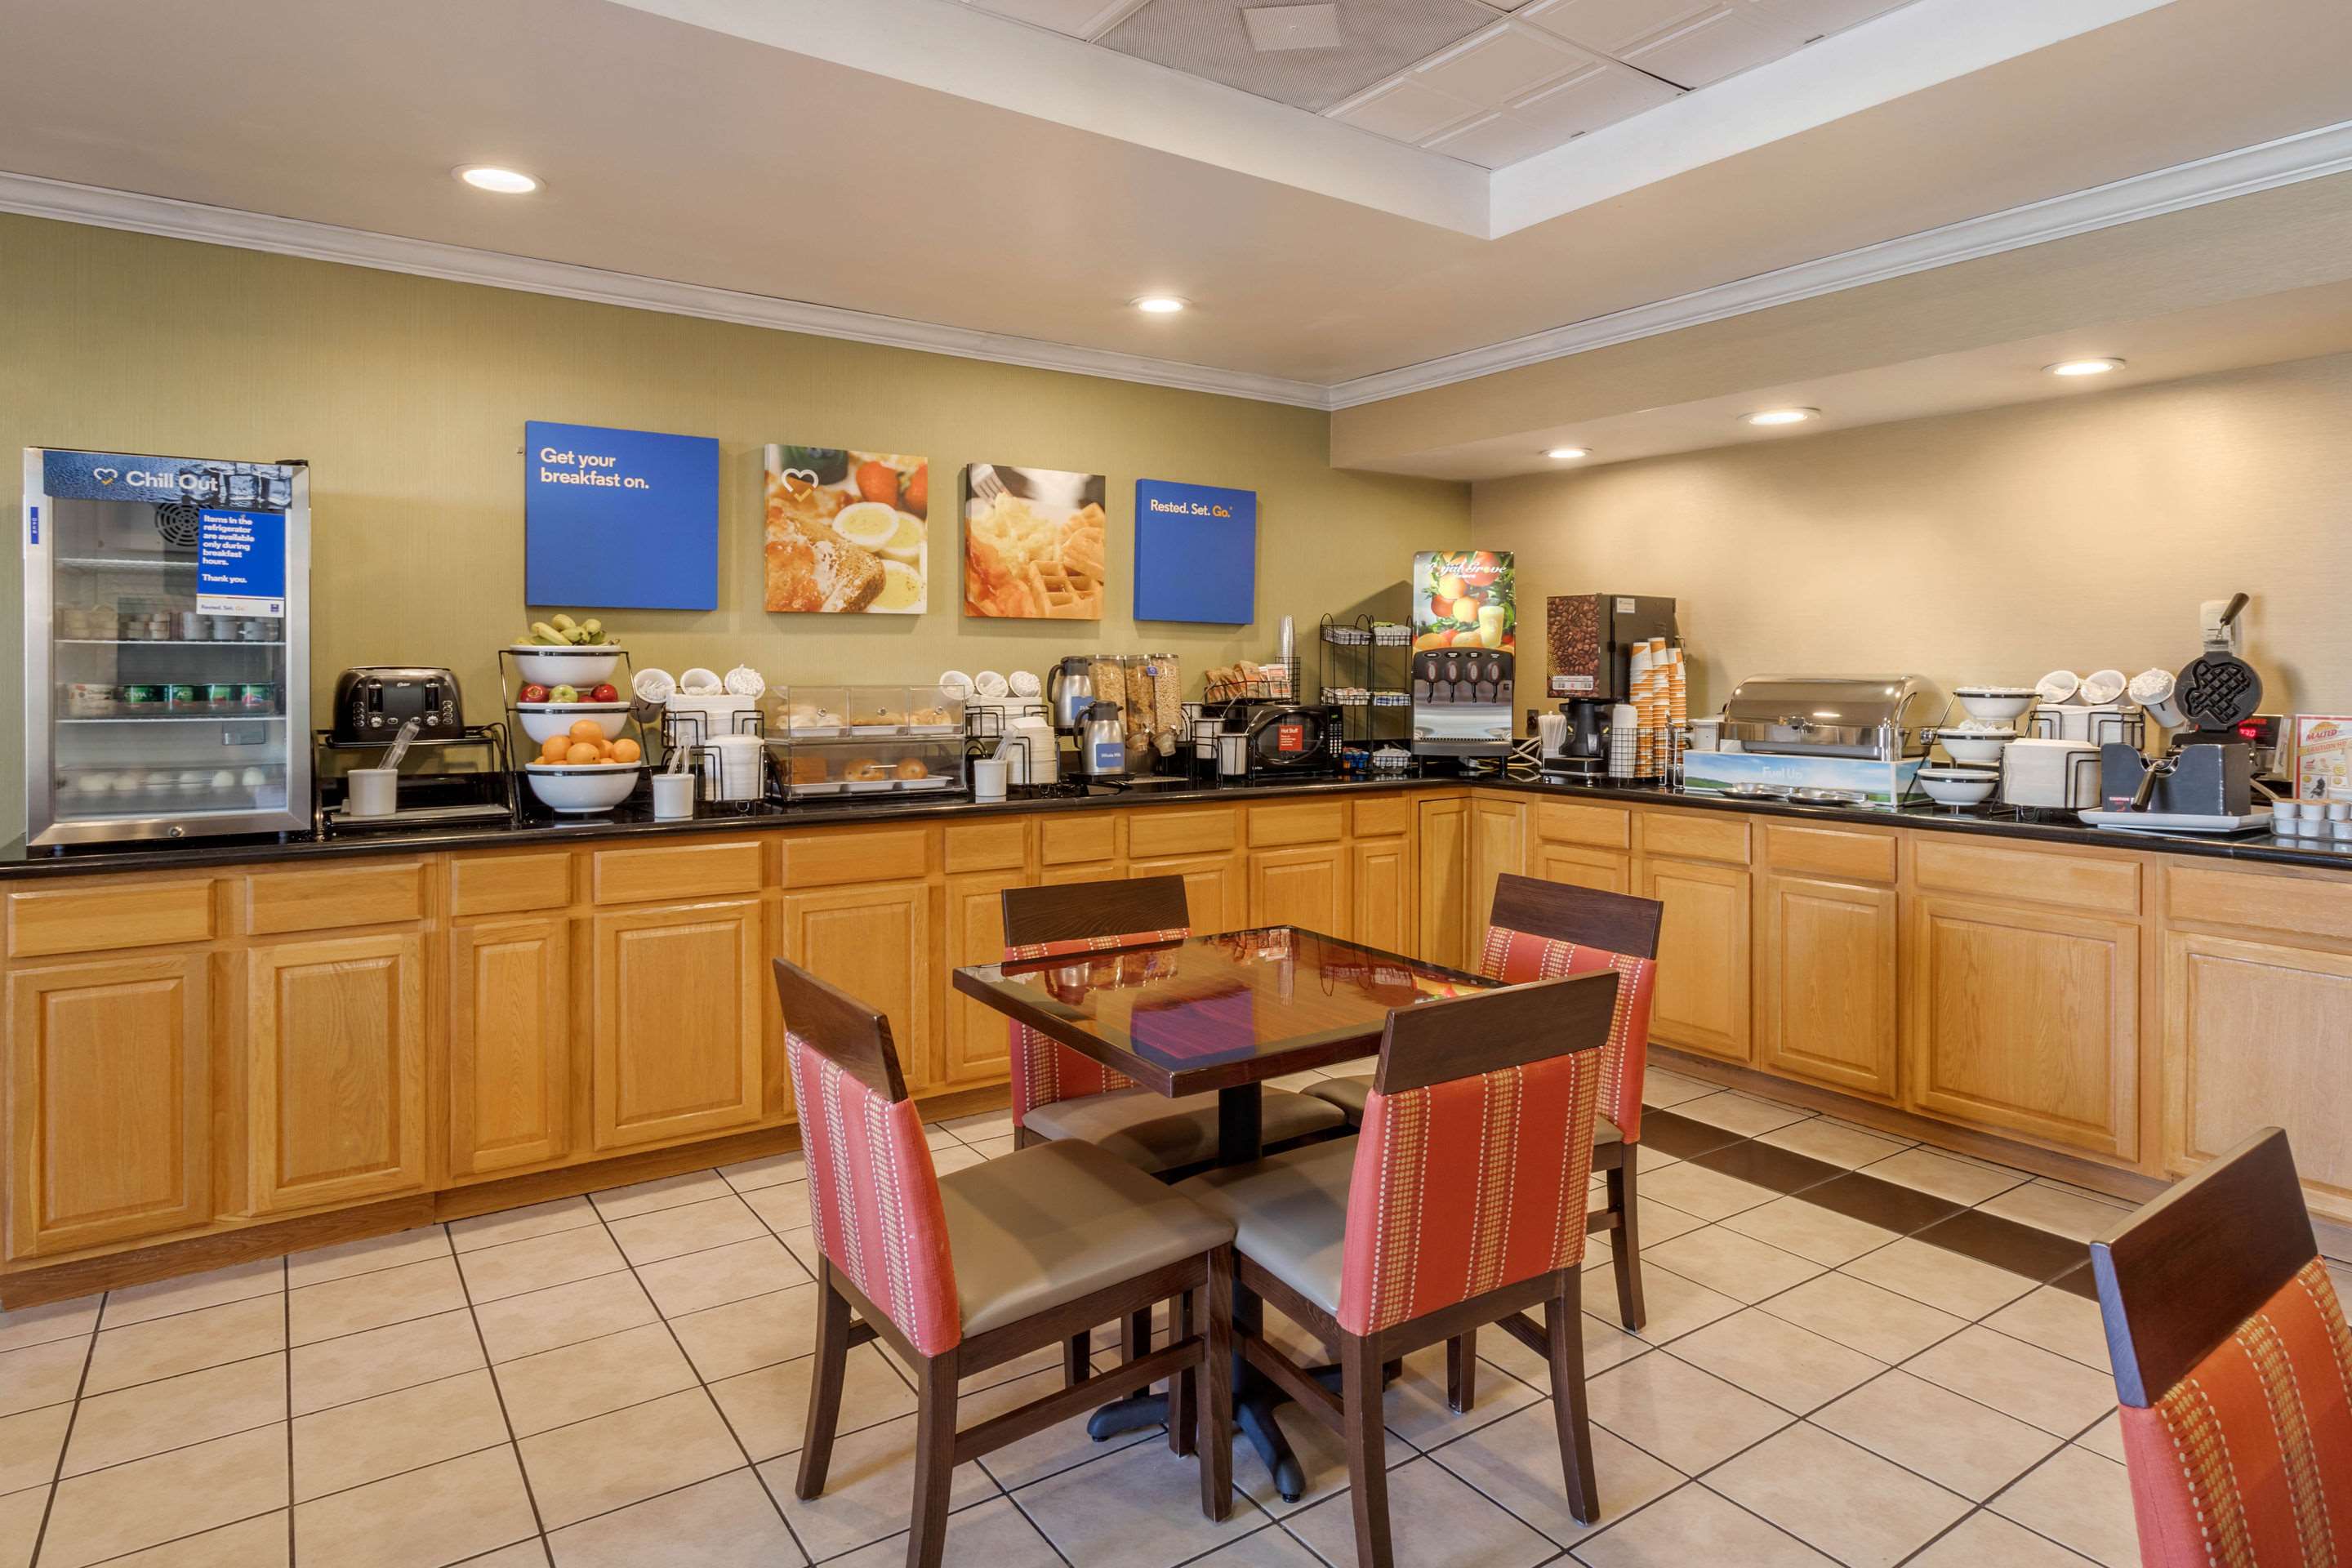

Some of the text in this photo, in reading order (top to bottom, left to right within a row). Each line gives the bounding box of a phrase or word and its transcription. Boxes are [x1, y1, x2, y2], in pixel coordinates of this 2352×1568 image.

[541, 448, 617, 468] Get your
[126, 470, 219, 492] Chill Out
[541, 466, 649, 489] breakfast on.
[1150, 499, 1189, 514] Rested.
[1191, 503, 1210, 516] Set.
[203, 514, 253, 525] Items in the
[203, 523, 252, 533] refrigerator
[218, 533, 255, 542] available
[203, 541, 251, 551] only during
[203, 548, 243, 558] breakfast
[202, 557, 229, 566] hours.
[1466, 561, 1507, 573] Grove
[202, 573, 247, 584] Thank you.
[1762, 766, 1803, 782] Fuel Up
